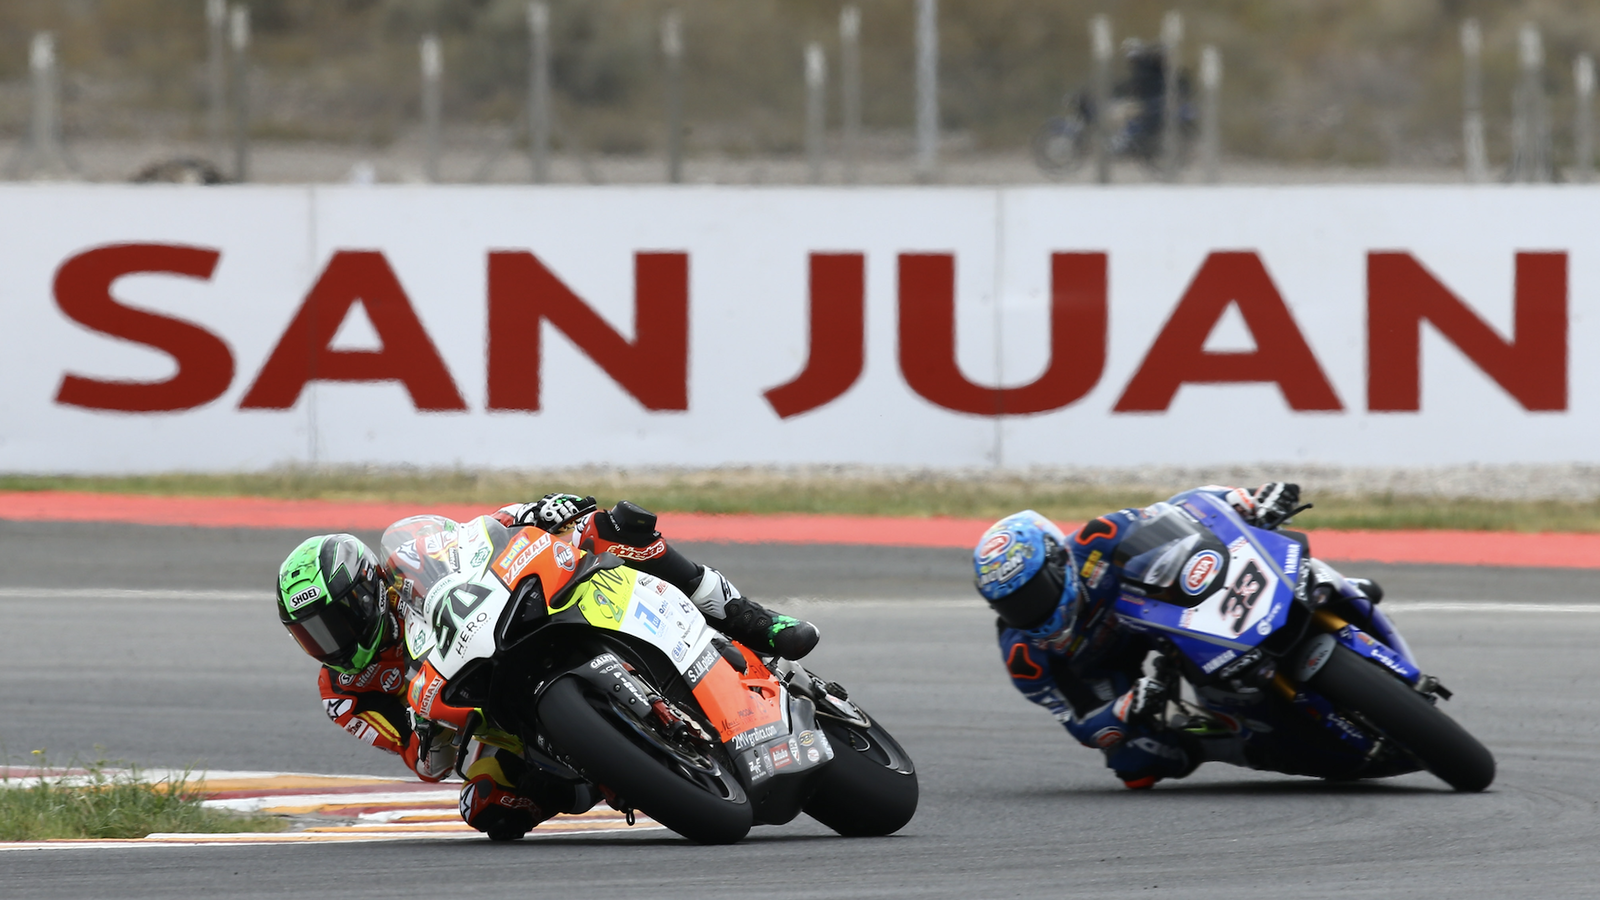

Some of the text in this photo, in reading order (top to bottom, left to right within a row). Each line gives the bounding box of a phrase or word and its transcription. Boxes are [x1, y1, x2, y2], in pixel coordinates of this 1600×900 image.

[54, 244, 1568, 418] SAN JUAN
[503, 534, 550, 585] VIGNALI
[555, 546, 573, 567] NILS
[1188, 559, 1214, 586] PATA
[1284, 543, 1301, 575] YAMAHA
[291, 588, 317, 607] SHOEI
[1220, 559, 1268, 634] 33
[456, 612, 488, 656] HERO
[382, 667, 401, 692] NILS
[613, 671, 650, 706] PIRELLI
